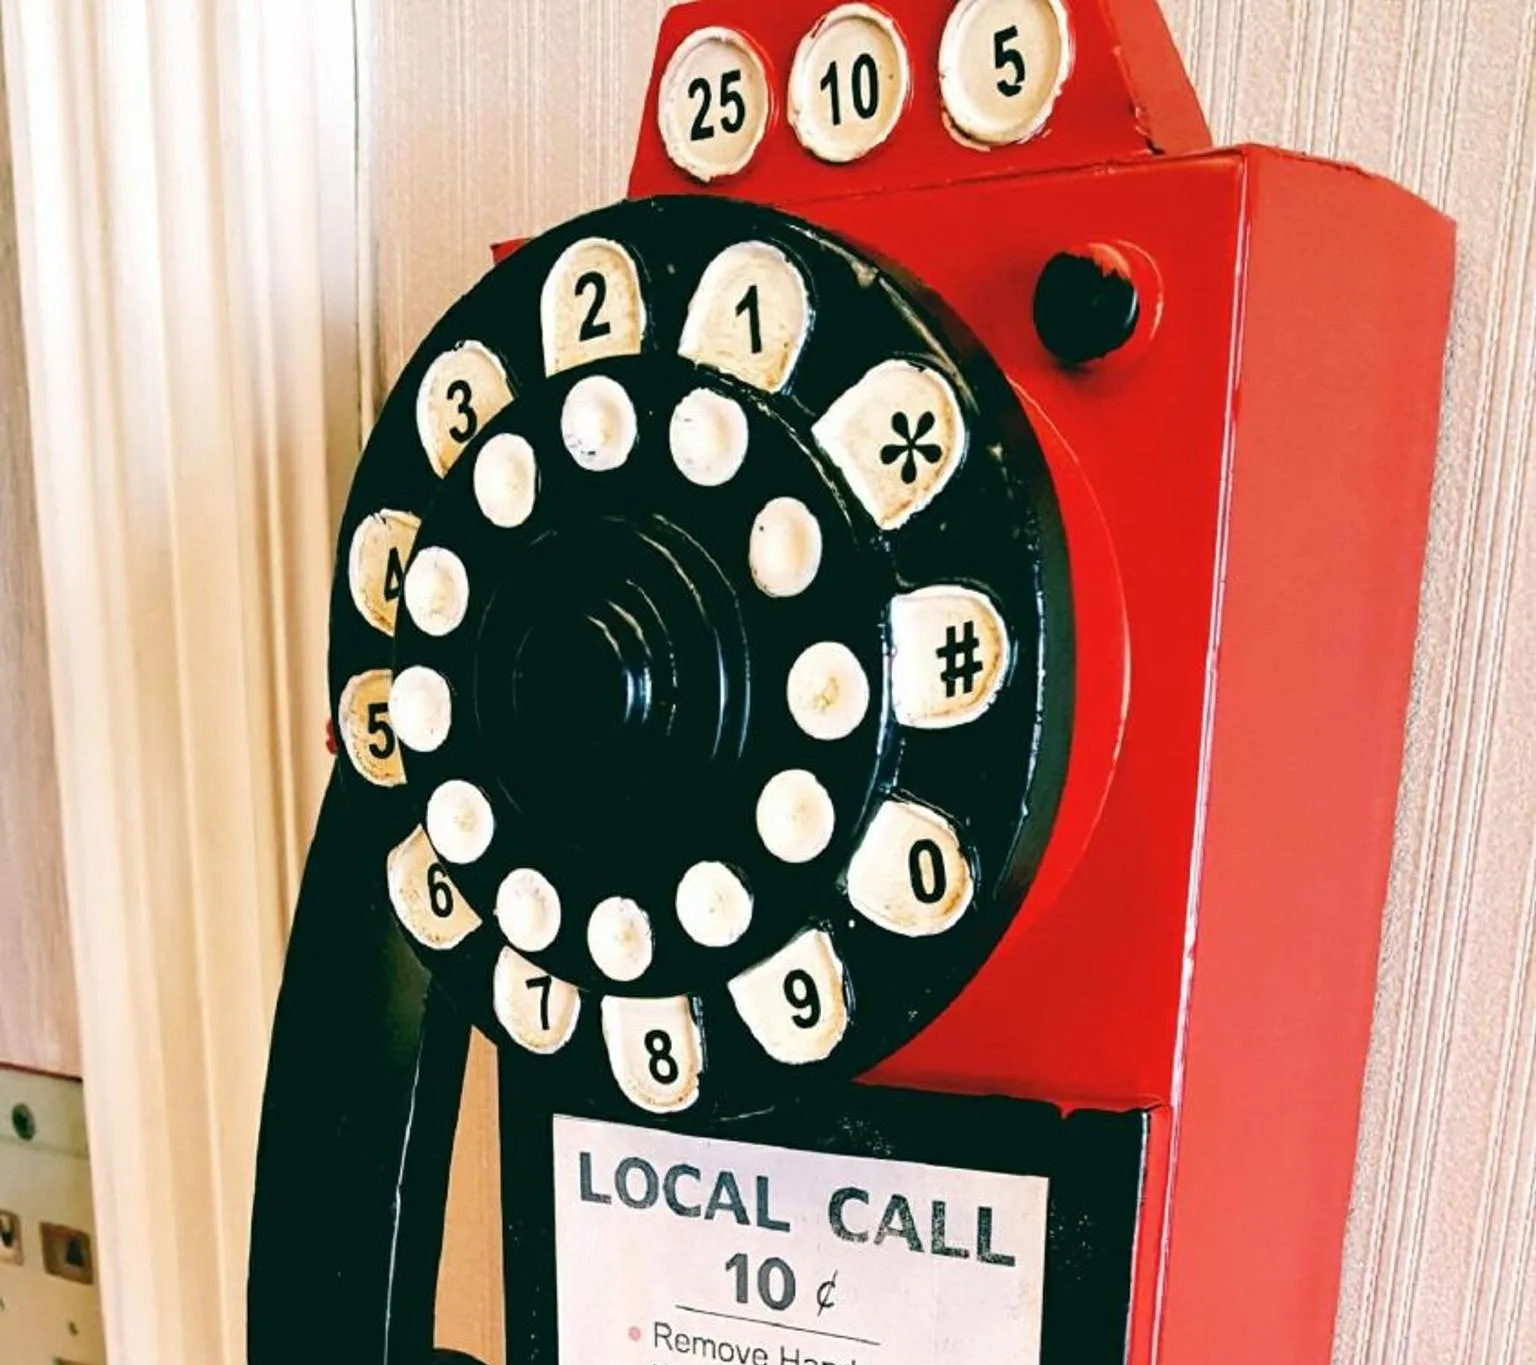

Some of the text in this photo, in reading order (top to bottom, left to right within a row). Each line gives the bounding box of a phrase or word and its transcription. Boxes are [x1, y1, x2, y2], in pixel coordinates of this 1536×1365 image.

[688, 25, 1026, 142] 25 10 5
[574, 271, 611, 342] 2
[735, 285, 762, 353] 1
[446, 380, 478, 443] 3
[367, 702, 395, 759] 5
[427, 863, 454, 918] 6
[909, 839, 947, 904] 0
[525, 975, 552, 1030] 7
[783, 969, 822, 1029] 9
[644, 1029, 679, 1085] 8
[579, 1151, 1016, 1267] LOCAL CALL
[725, 1252, 796, 1311] 10
